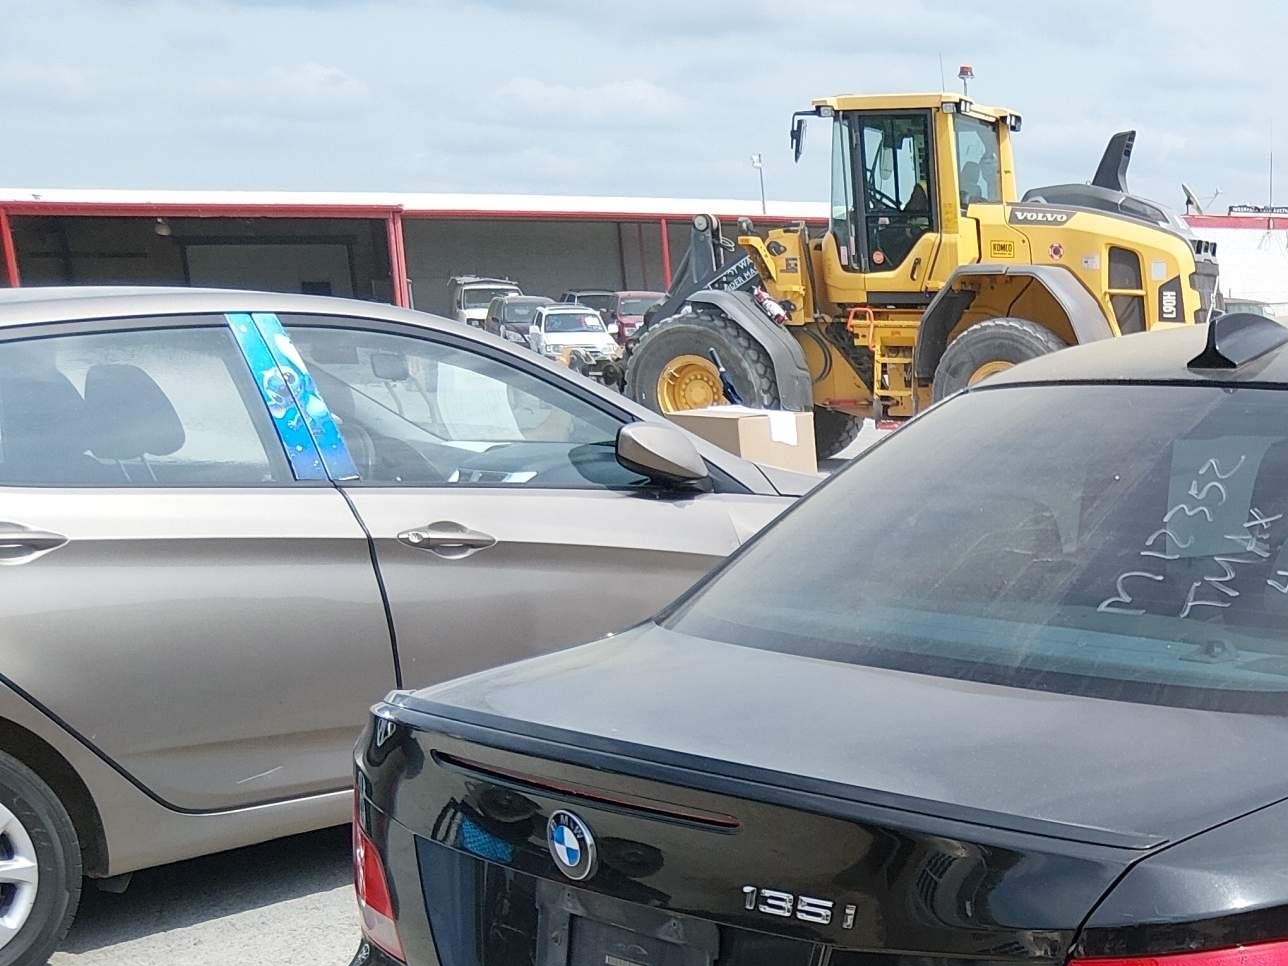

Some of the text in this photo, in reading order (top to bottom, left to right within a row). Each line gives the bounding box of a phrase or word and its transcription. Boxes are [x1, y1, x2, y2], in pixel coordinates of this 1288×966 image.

[1015, 211, 1068, 222] VOLVO
[1162, 291, 1177, 318] L90H
[550, 814, 584, 839] BMW
